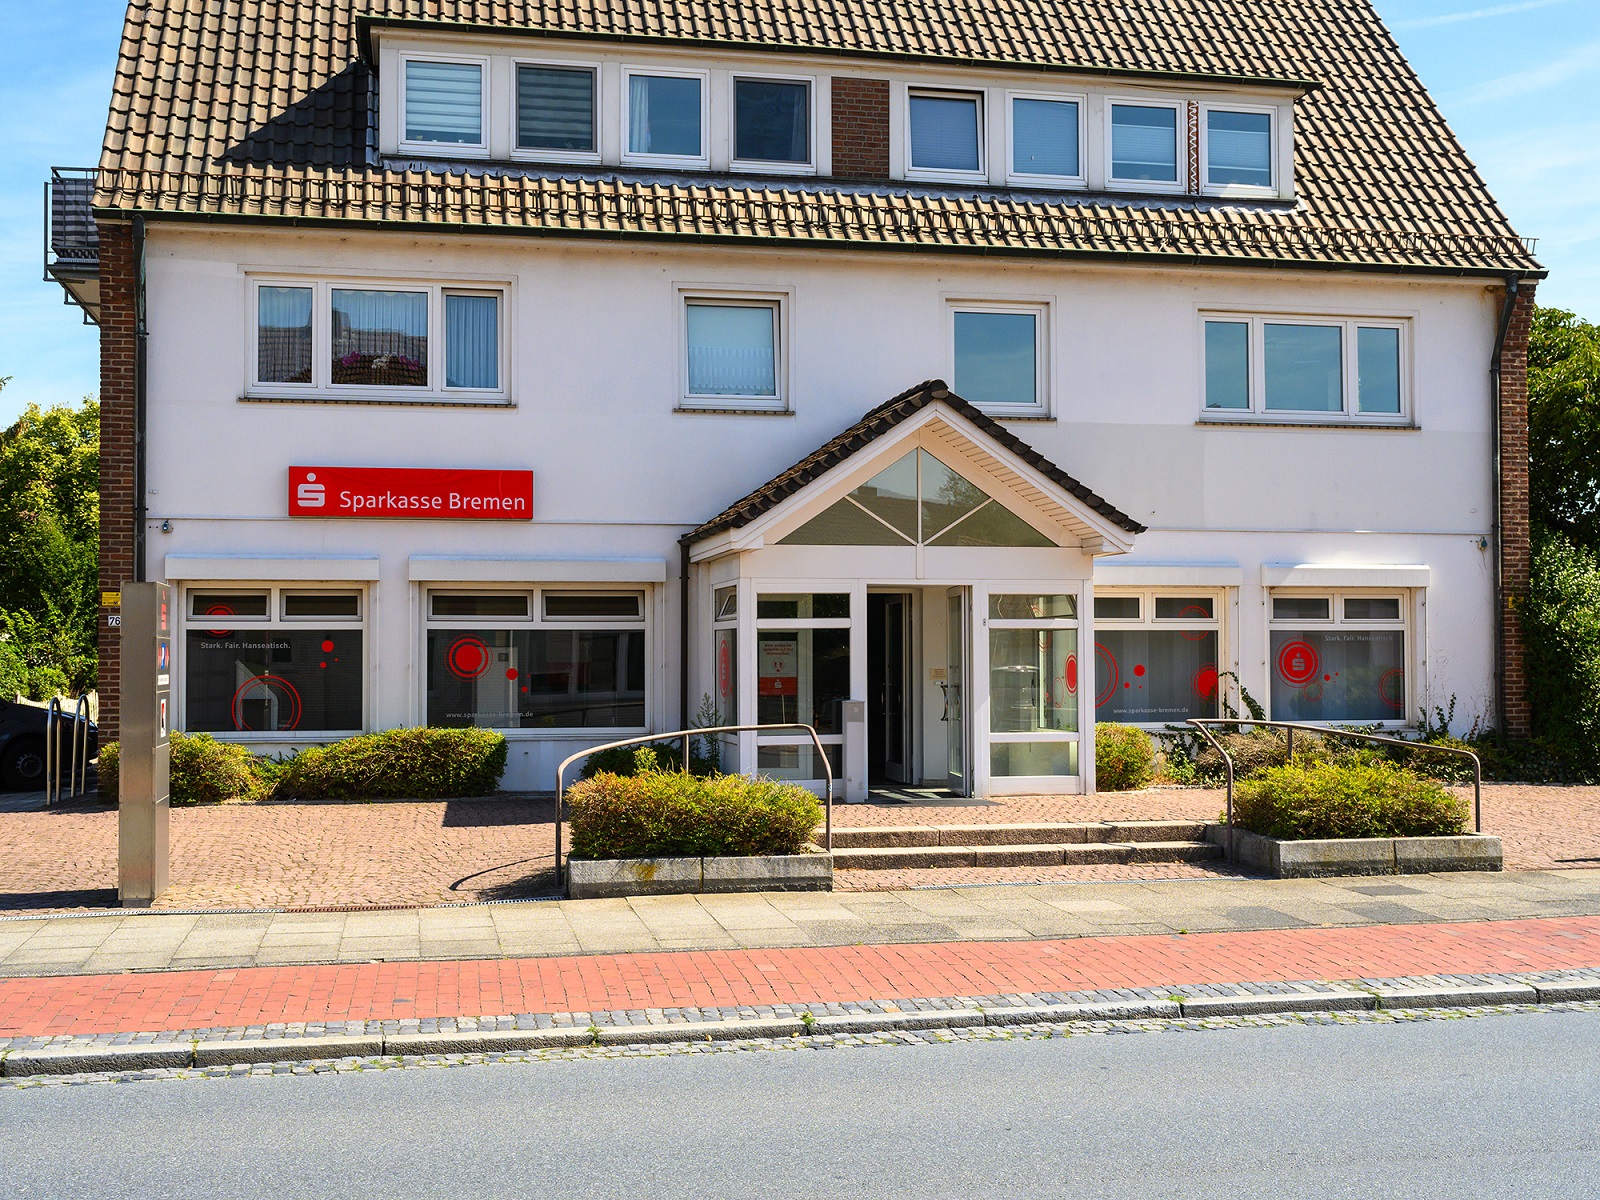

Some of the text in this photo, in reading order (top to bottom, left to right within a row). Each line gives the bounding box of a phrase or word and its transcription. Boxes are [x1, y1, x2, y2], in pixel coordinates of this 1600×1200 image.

[339, 490, 443, 512] Sparkasse
[448, 493, 525, 510] Bremen
[109, 616, 121, 626] 76
[1113, 706, 1189, 714] www.sparkasse-bremen.de
